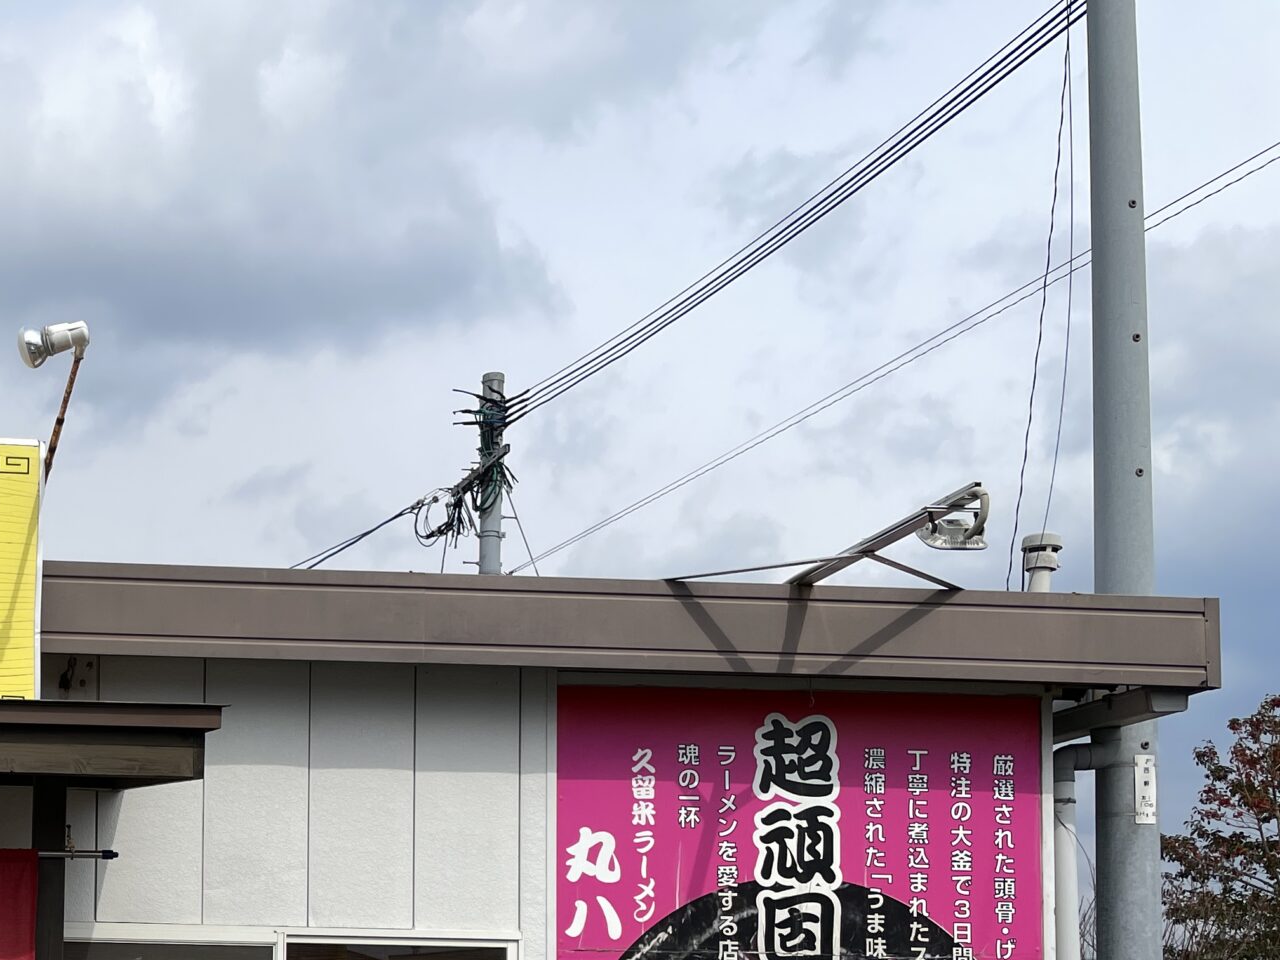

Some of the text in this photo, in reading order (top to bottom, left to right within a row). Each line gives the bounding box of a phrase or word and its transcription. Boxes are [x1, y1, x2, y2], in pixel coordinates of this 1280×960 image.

[631, 747, 656, 923] 久留米ラーメン
[677, 743, 701, 828] 魂の一杯
[565, 826, 622, 940] 丸八
